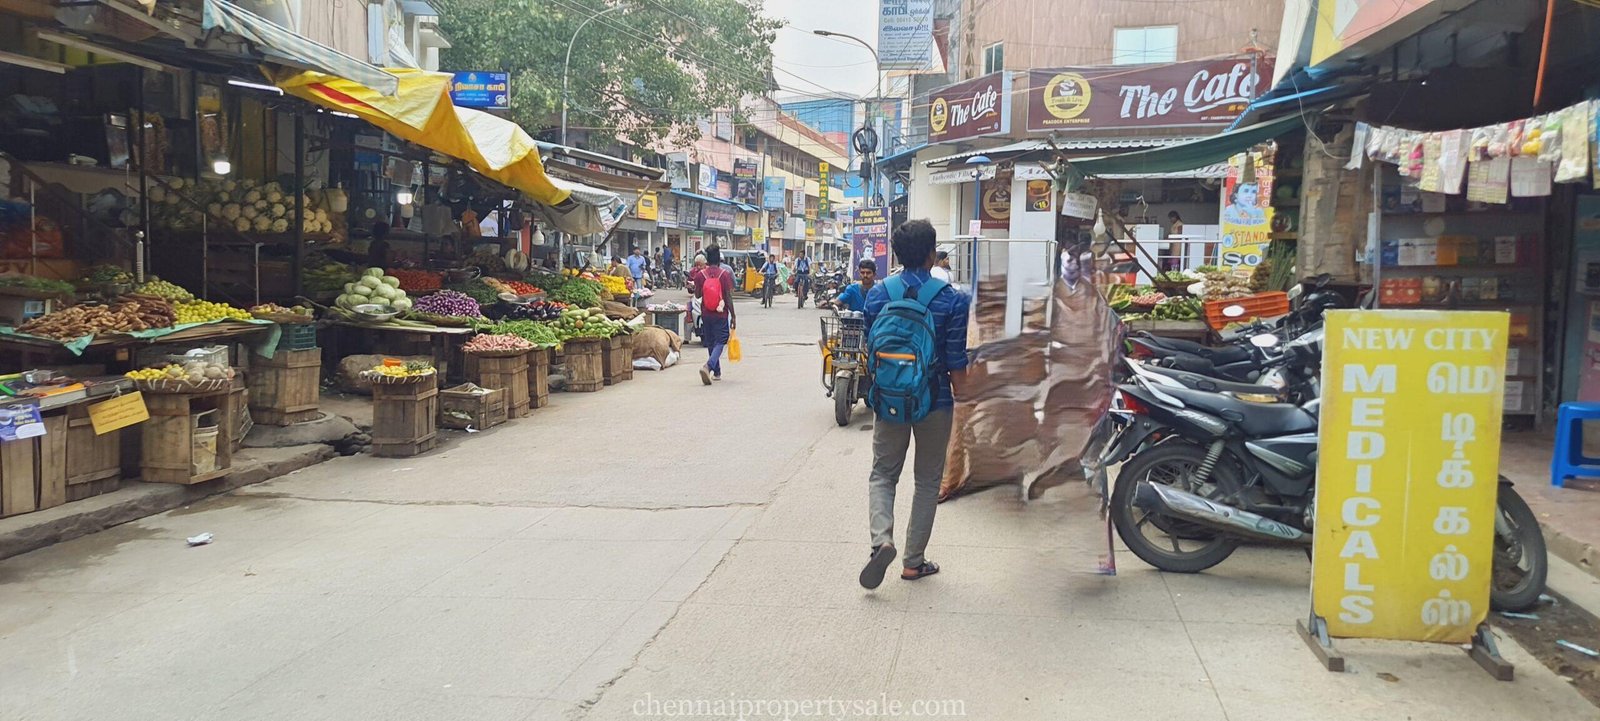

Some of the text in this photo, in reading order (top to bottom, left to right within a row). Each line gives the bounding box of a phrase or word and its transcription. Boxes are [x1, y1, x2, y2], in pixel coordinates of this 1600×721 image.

[950, 84, 997, 127] The Cafe
[1119, 62, 1260, 119] The Cafe
[1342, 327, 1499, 350] NEW CITY
[1338, 364, 1397, 625] MEDICALS
